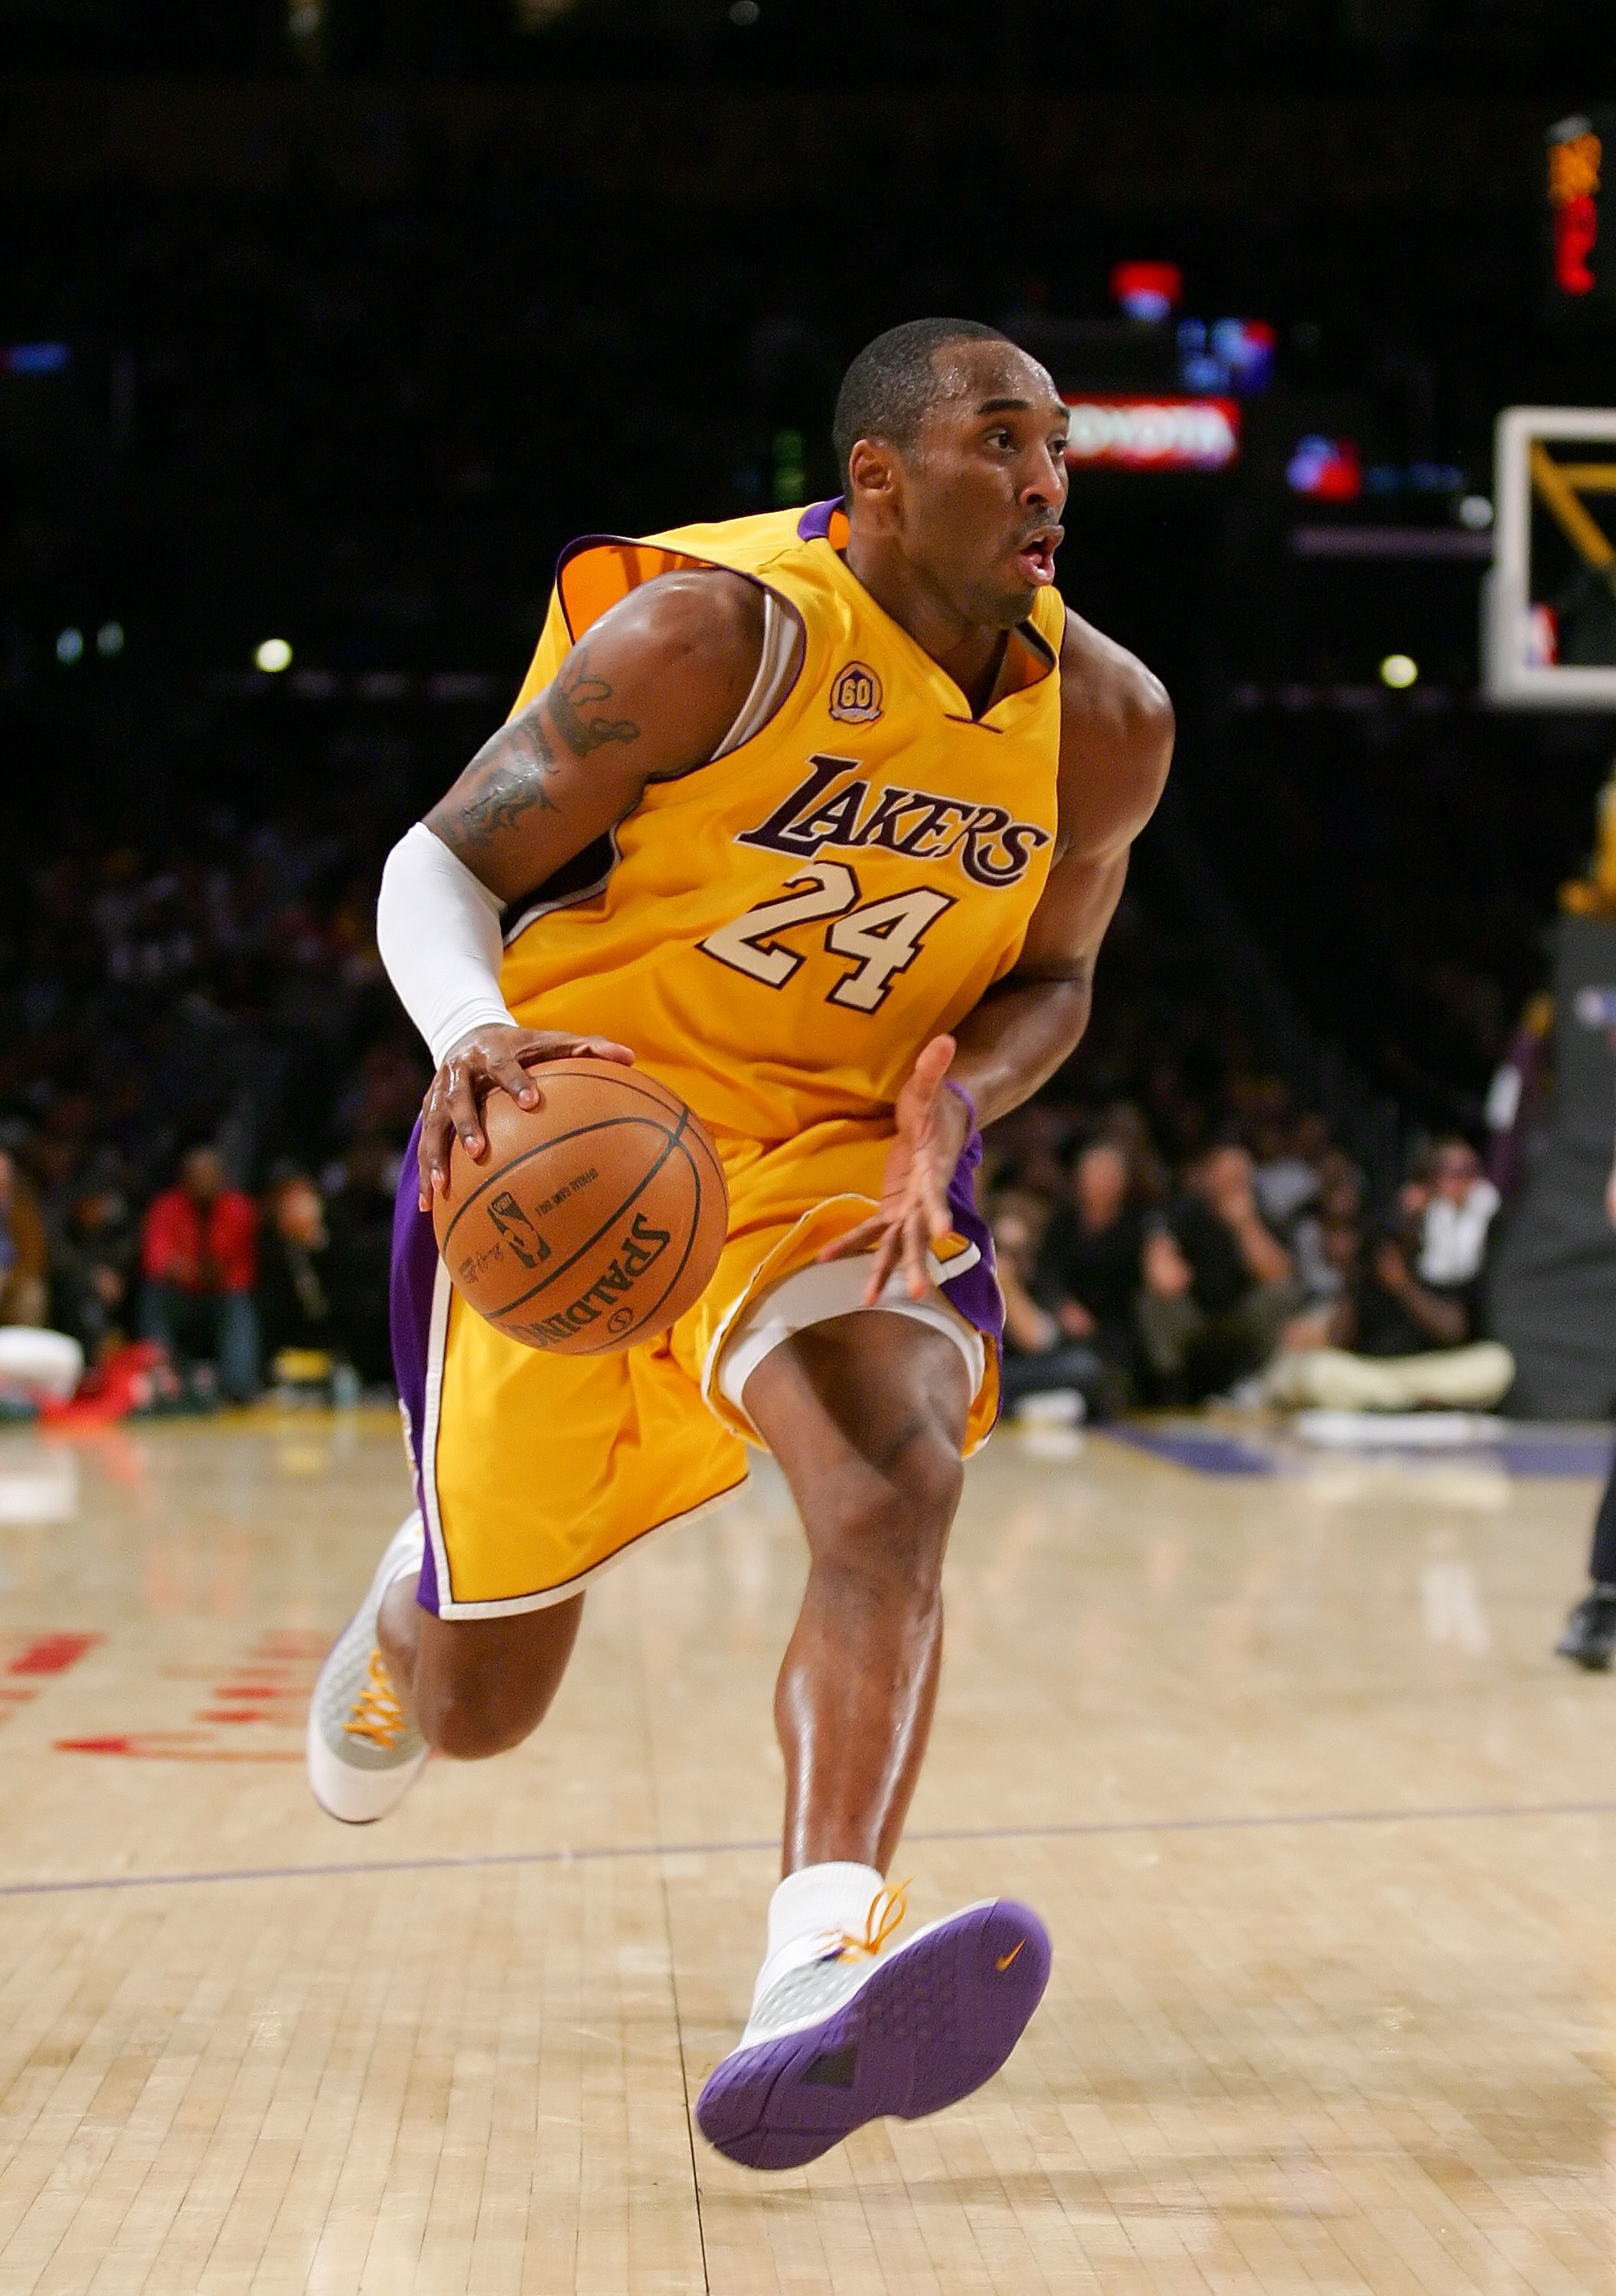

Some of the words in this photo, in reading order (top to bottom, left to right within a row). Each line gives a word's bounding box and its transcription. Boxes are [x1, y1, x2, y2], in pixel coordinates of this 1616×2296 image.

[841, 677, 871, 708] 60
[733, 752, 1056, 889] LAKERS
[694, 859, 959, 1016] 24
